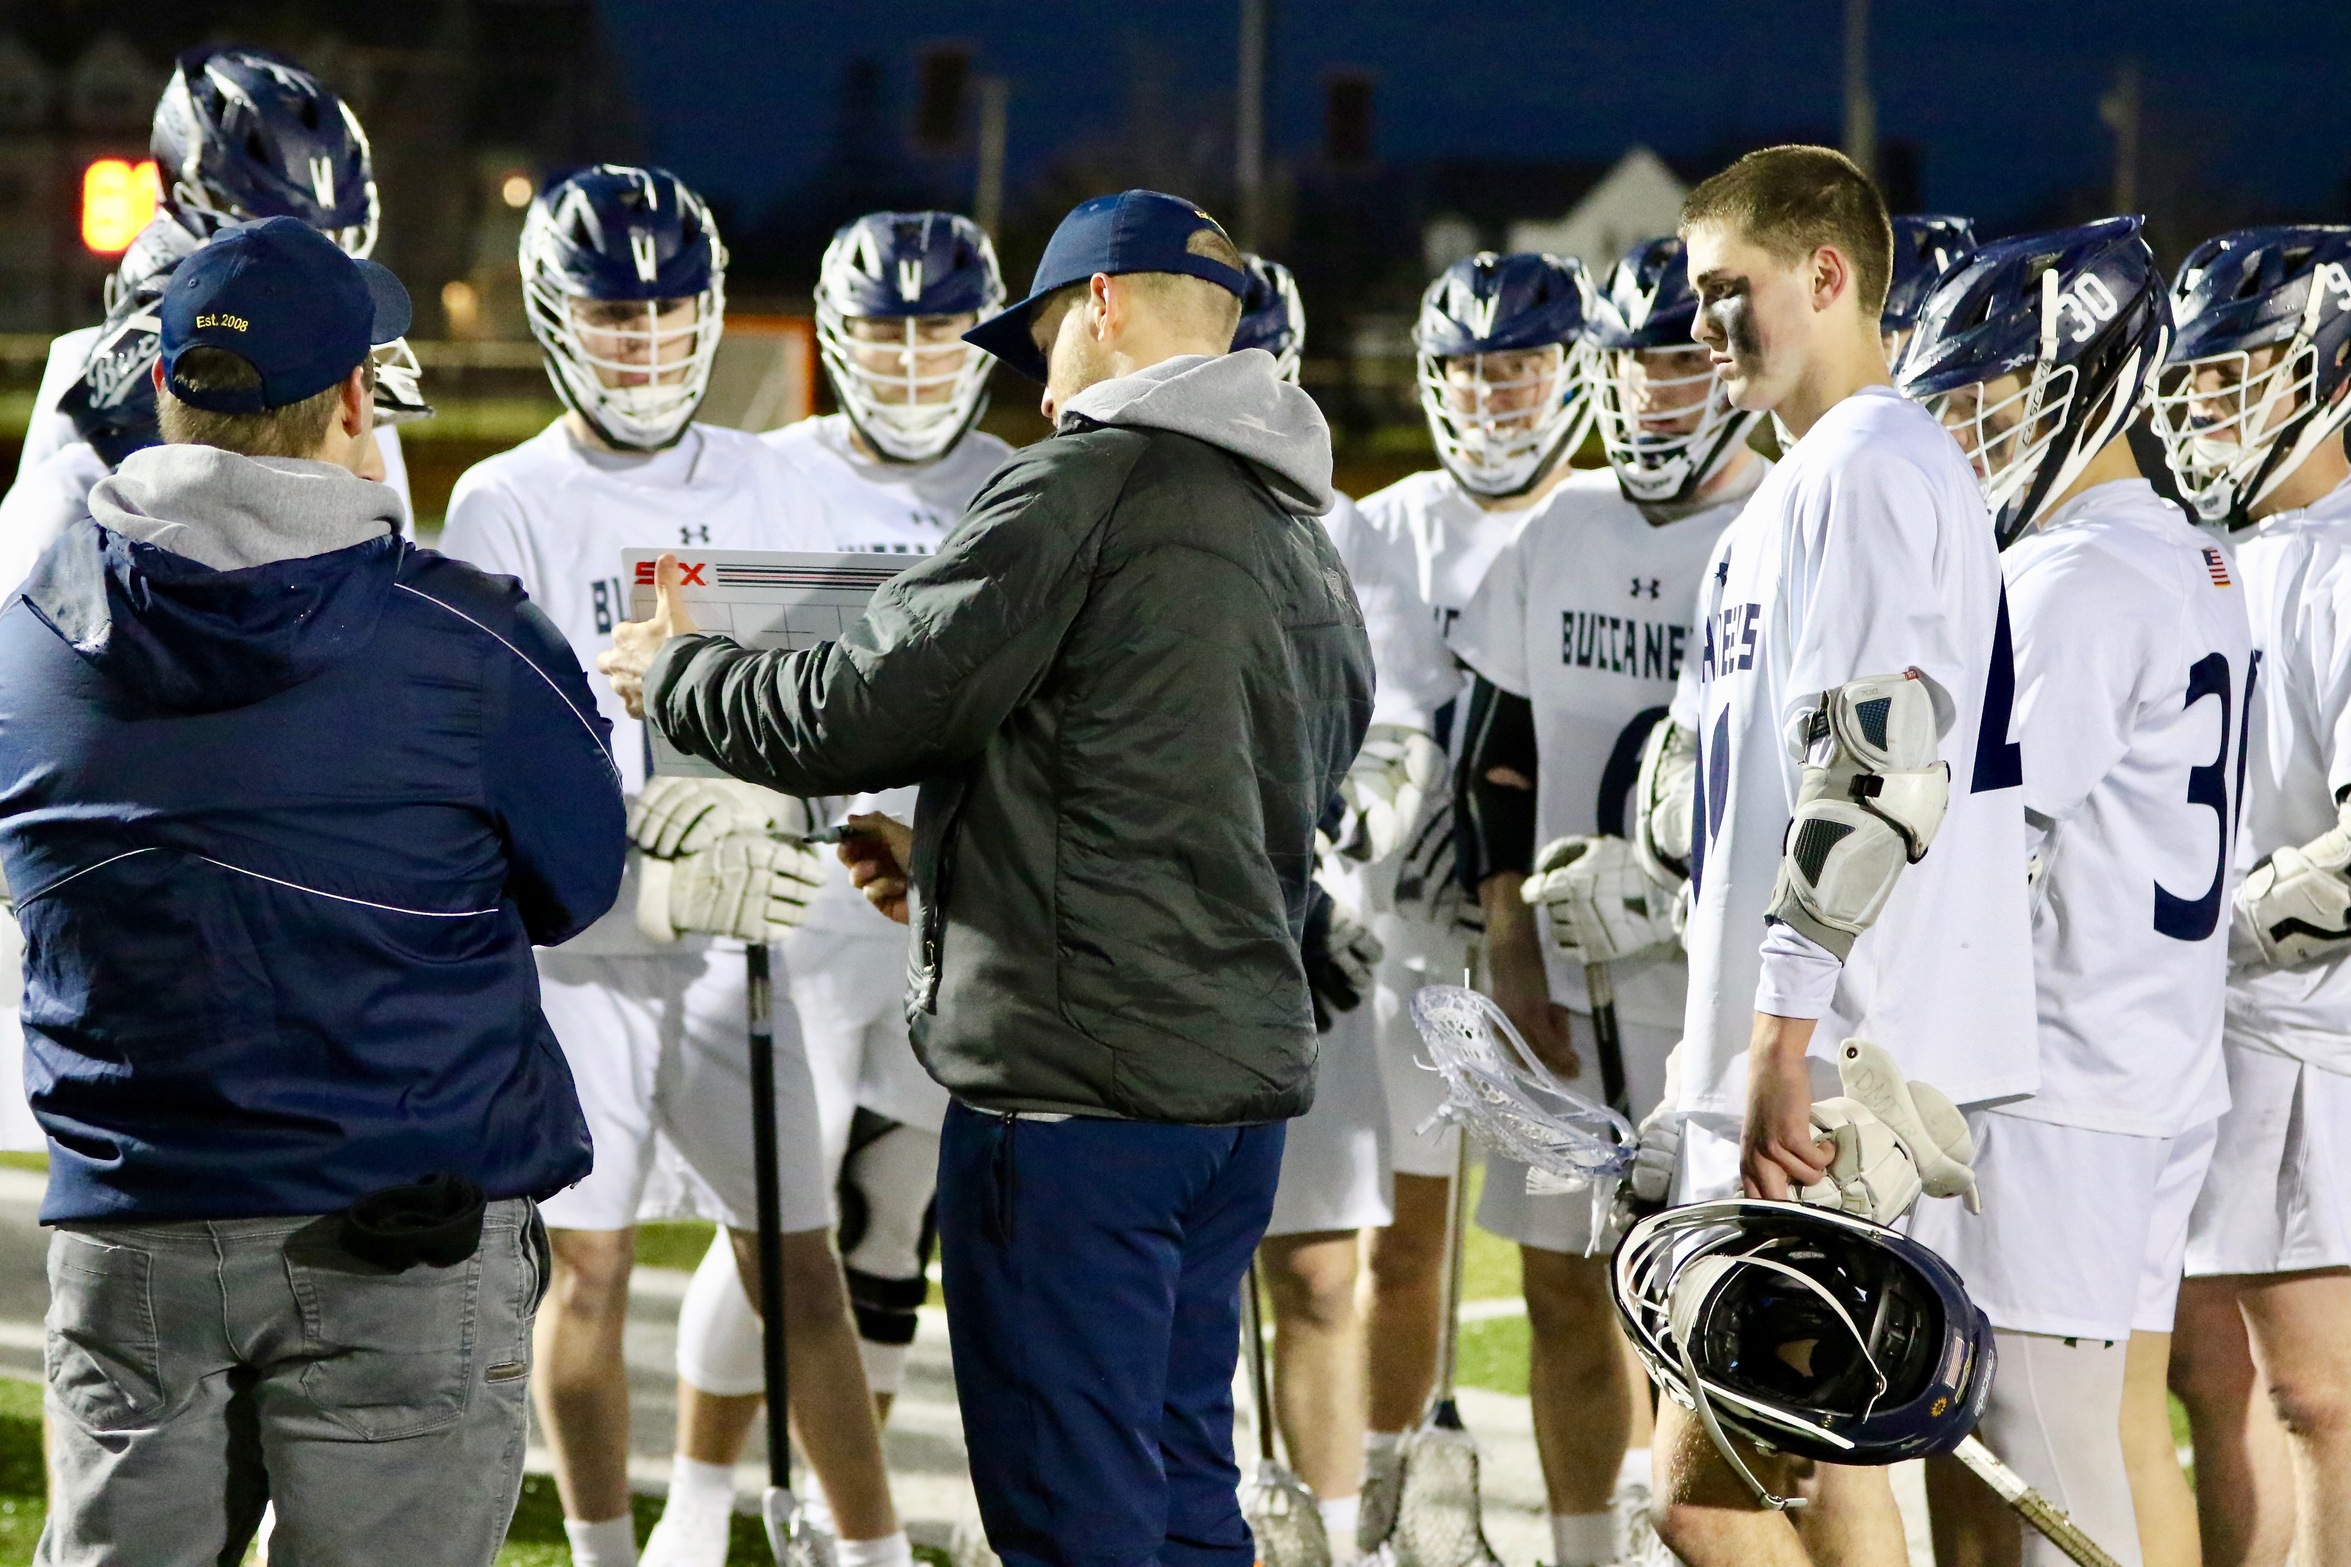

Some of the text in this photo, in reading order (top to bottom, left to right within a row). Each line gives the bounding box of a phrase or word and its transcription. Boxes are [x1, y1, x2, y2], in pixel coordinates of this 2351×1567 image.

[196, 313, 249, 332] Est. 2008
[2057, 272, 2118, 343] 30
[634, 561, 706, 586] SX
[1562, 610, 1694, 682] BUCCANE
[1861, 687, 1879, 697] 700
[1973, 1348, 1995, 1417] cascade
